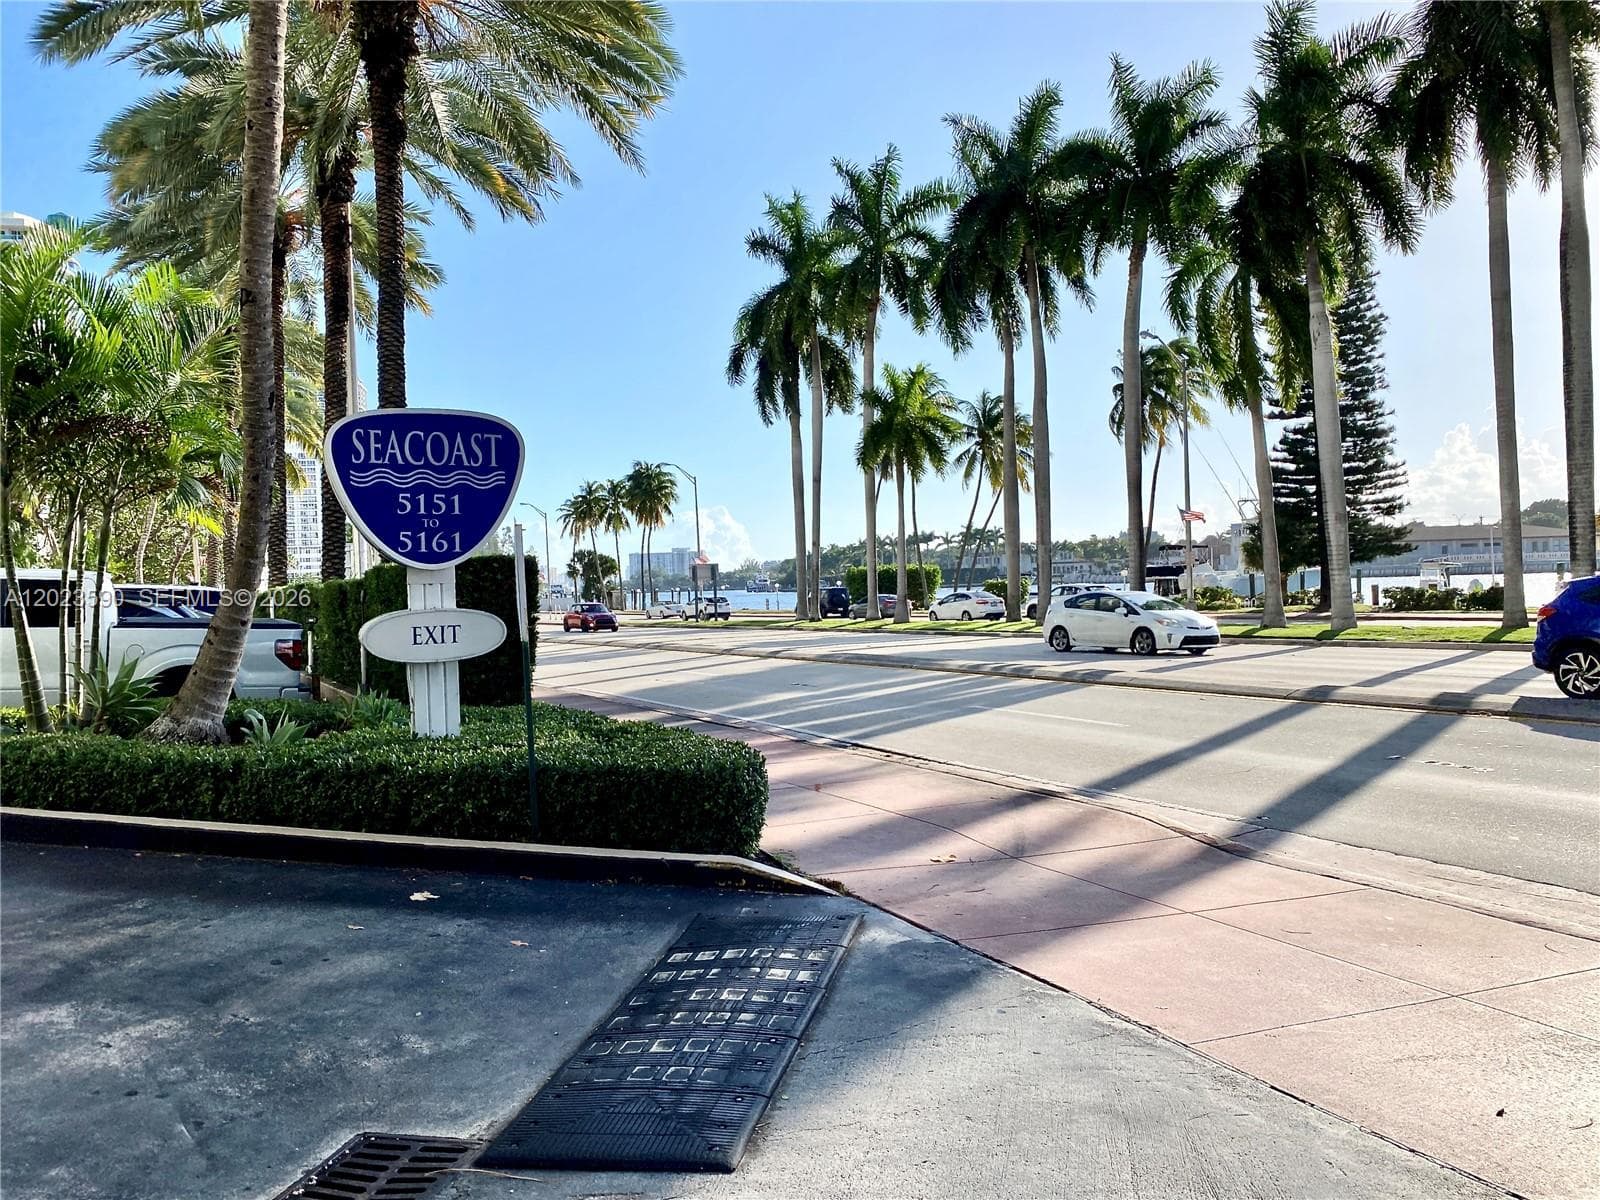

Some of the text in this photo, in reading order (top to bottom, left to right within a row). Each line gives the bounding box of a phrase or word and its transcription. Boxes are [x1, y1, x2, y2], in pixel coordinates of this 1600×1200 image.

[351, 428, 502, 467] SEACOAST
[397, 493, 462, 515] 5151
[422, 518, 439, 528] TO
[398, 531, 462, 552] 5161
[412, 625, 462, 645] EXIT
